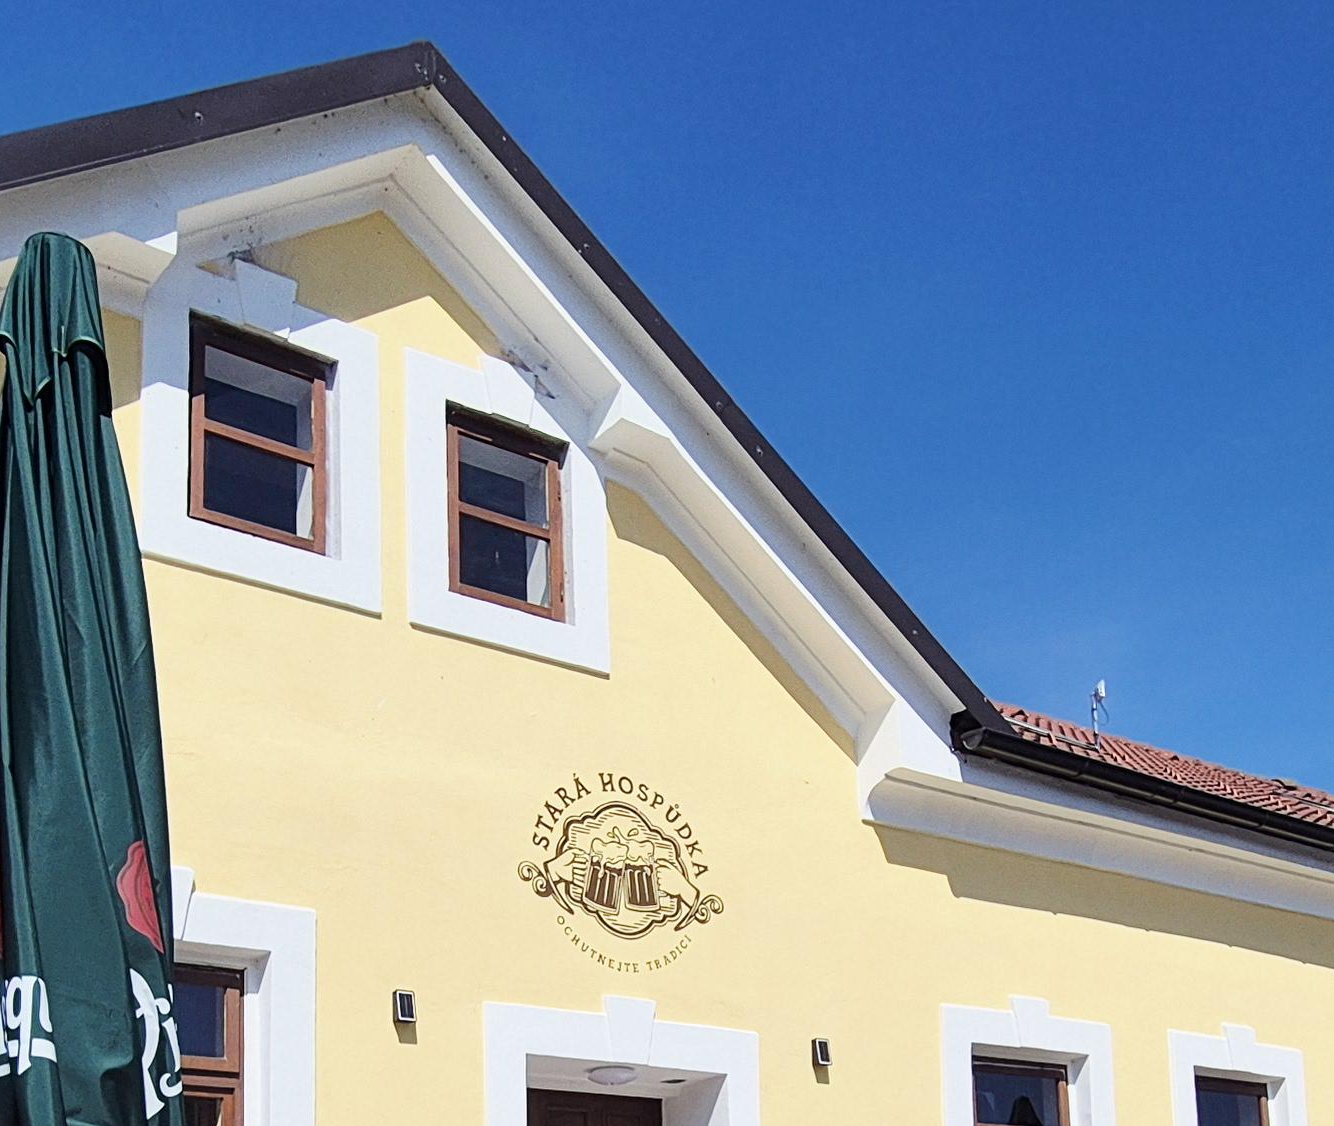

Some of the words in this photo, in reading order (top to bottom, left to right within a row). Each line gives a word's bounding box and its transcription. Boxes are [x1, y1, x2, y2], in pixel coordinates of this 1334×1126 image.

[532, 772, 592, 851] STARÁ
[598, 772, 709, 879] HOSPŮDKA
[556, 915, 639, 973] OCHUTNEJTE
[645, 934, 692, 971] TRADICI
